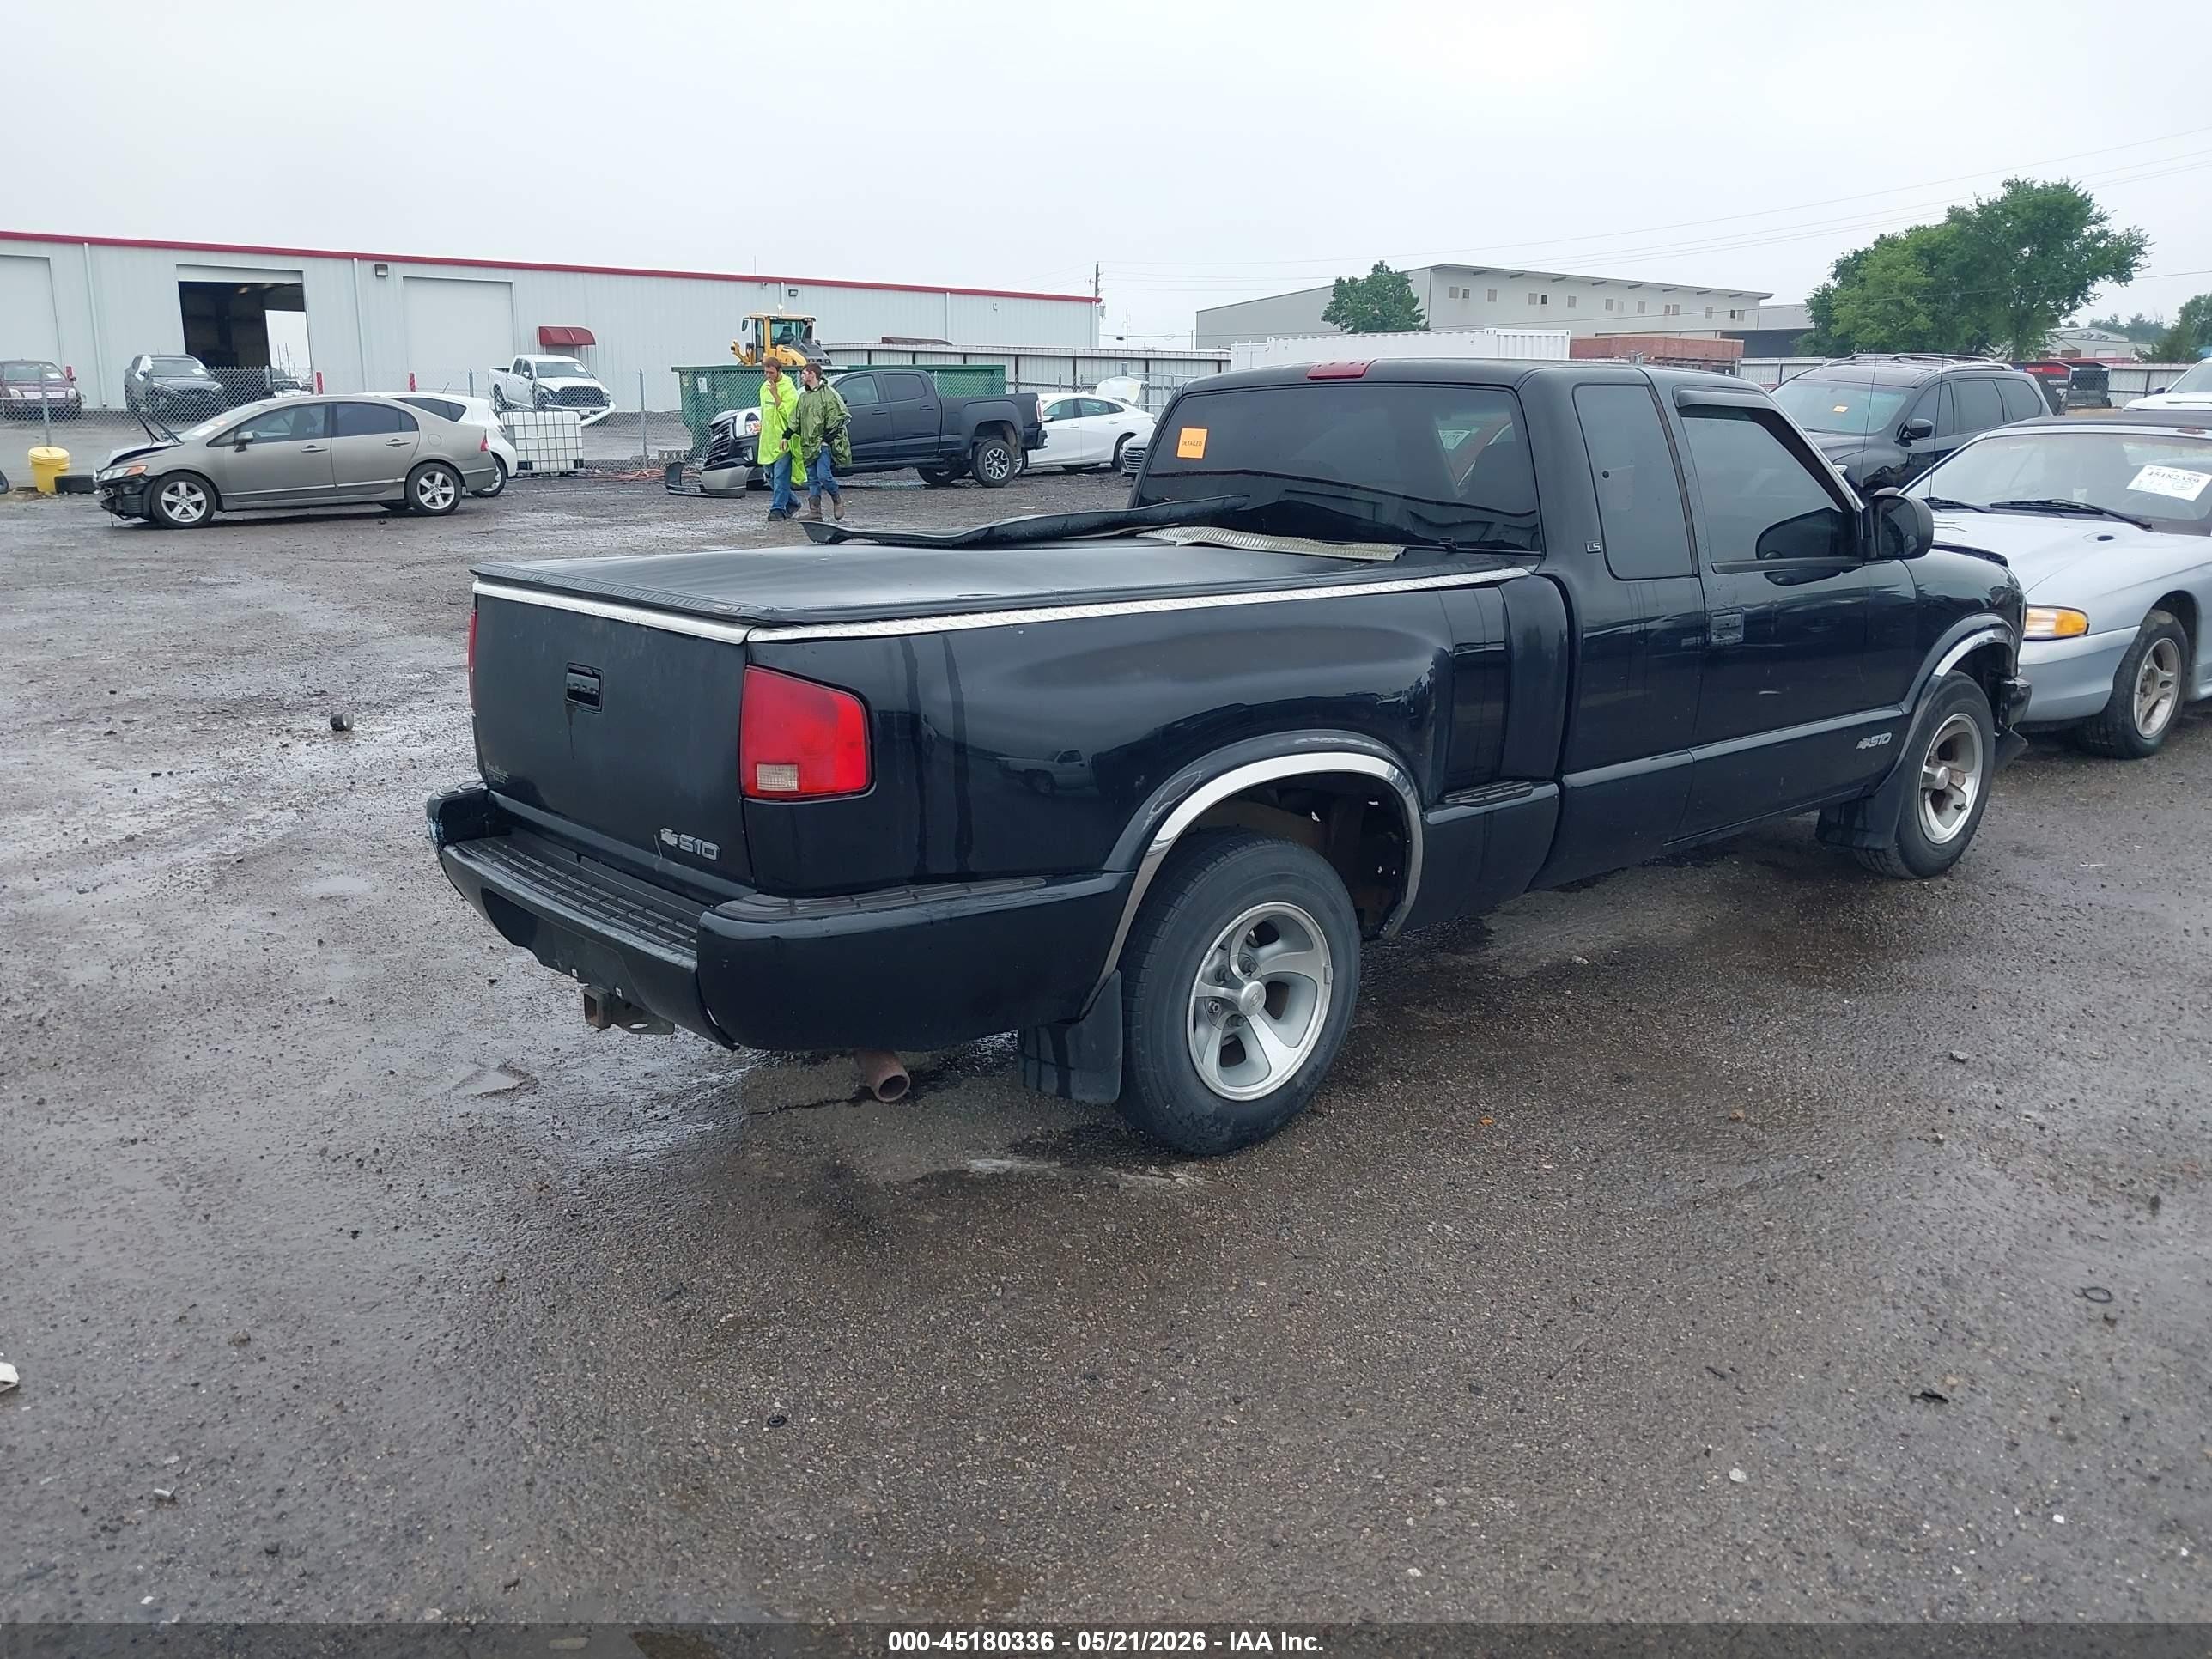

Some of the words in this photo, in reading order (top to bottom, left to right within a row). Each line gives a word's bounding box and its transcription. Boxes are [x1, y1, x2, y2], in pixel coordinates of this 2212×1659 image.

[1586, 542, 1601, 552] LS
[1869, 732, 1893, 747] S10
[679, 833, 720, 860] S10
